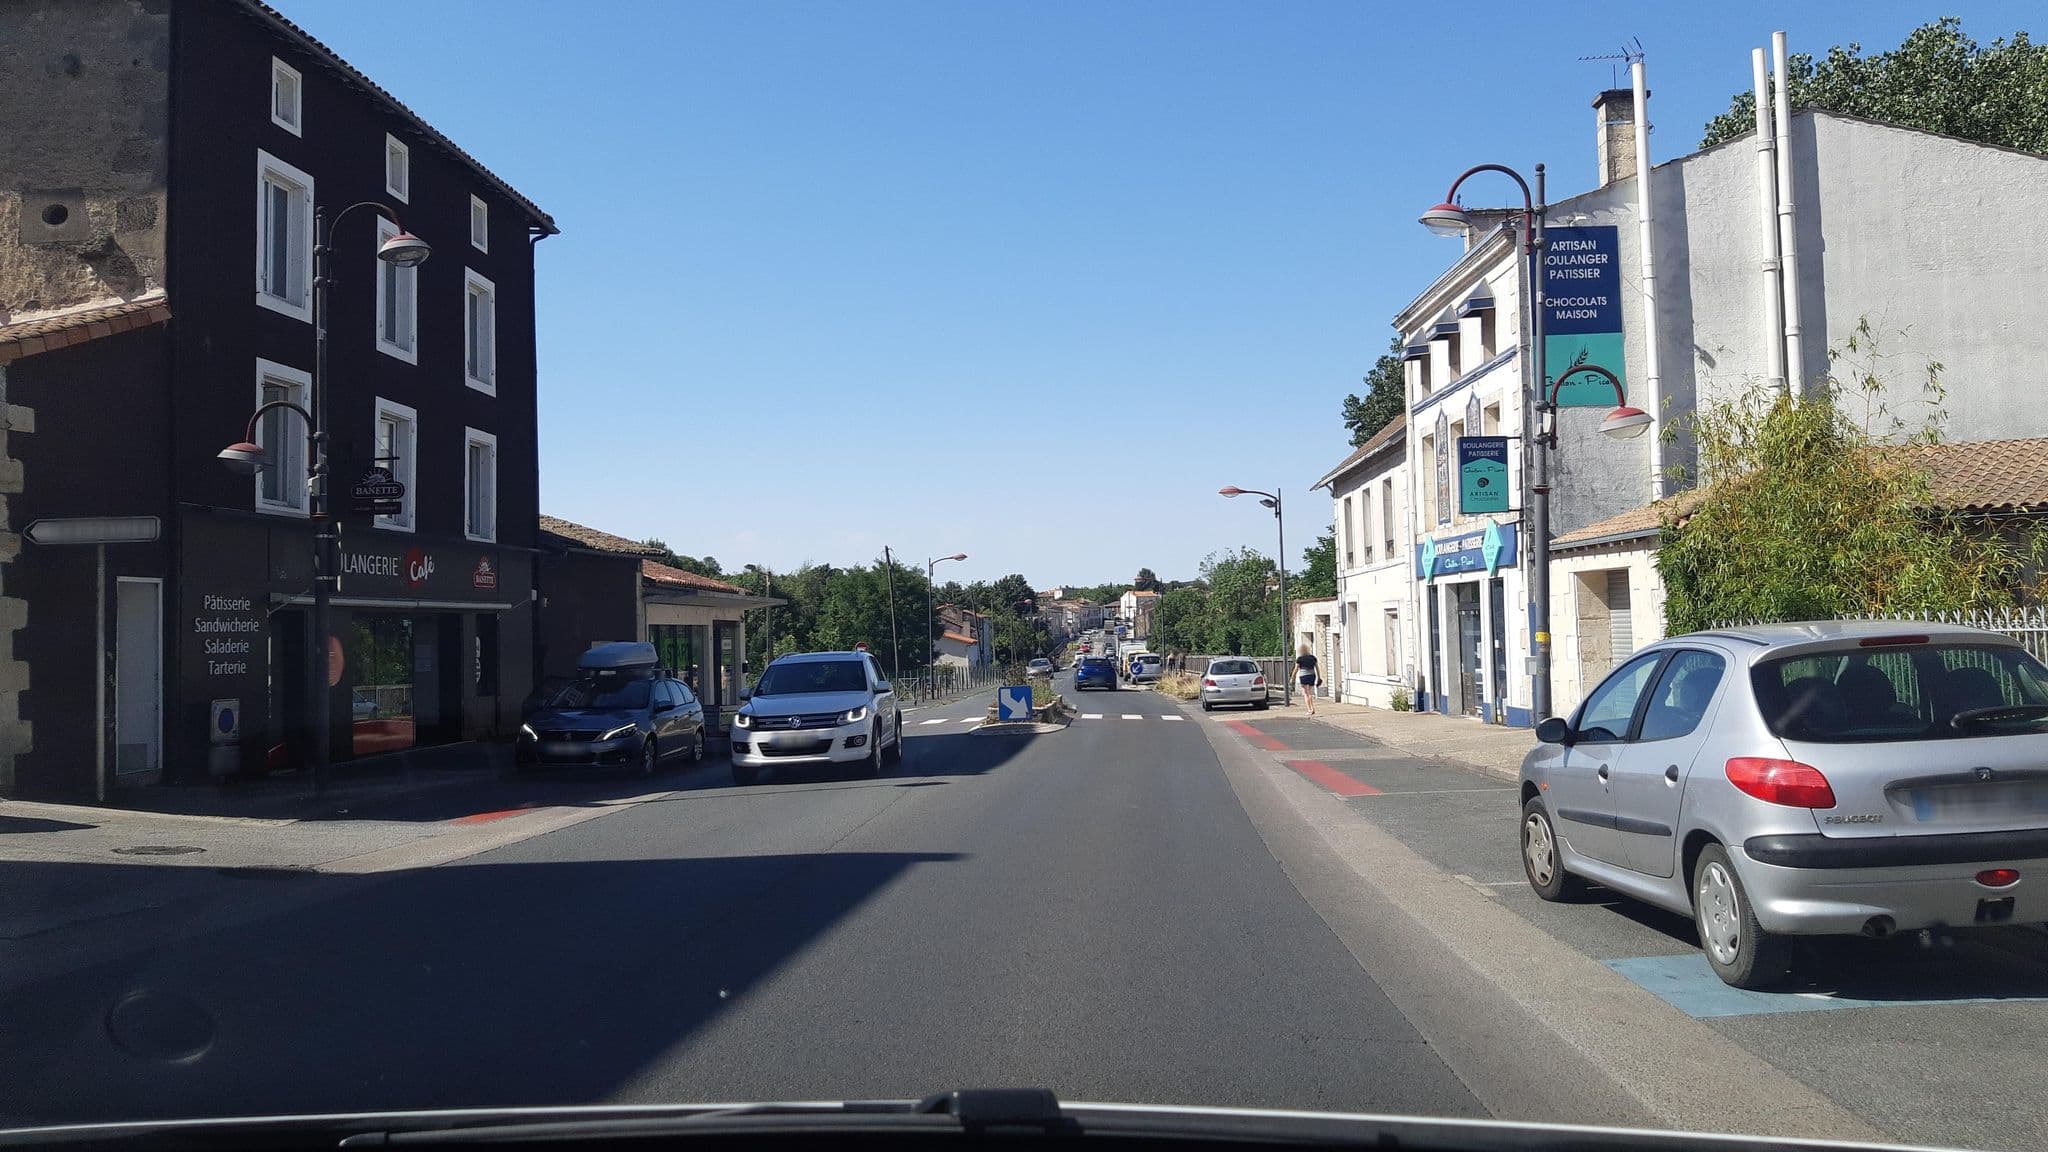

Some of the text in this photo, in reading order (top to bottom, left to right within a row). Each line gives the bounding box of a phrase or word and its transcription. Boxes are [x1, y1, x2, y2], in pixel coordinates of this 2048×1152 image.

[1550, 240, 1597, 252] ARTISAN
[1549, 268, 1601, 280] PATISSIER
[1545, 296, 1607, 308] CHOCOLATS
[1556, 309, 1597, 320] MAISON
[1463, 441, 1504, 449] BOULANGERIE
[356, 486, 398, 495] BANETTE
[410, 555, 435, 581] Café
[204, 594, 251, 611] Pâtisserie
[194, 616, 260, 633] Sandwicherie
[204, 638, 250, 654] Saladerie
[208, 660, 247, 675] Tarterie
[1824, 814, 1884, 825] PEUGEOT
